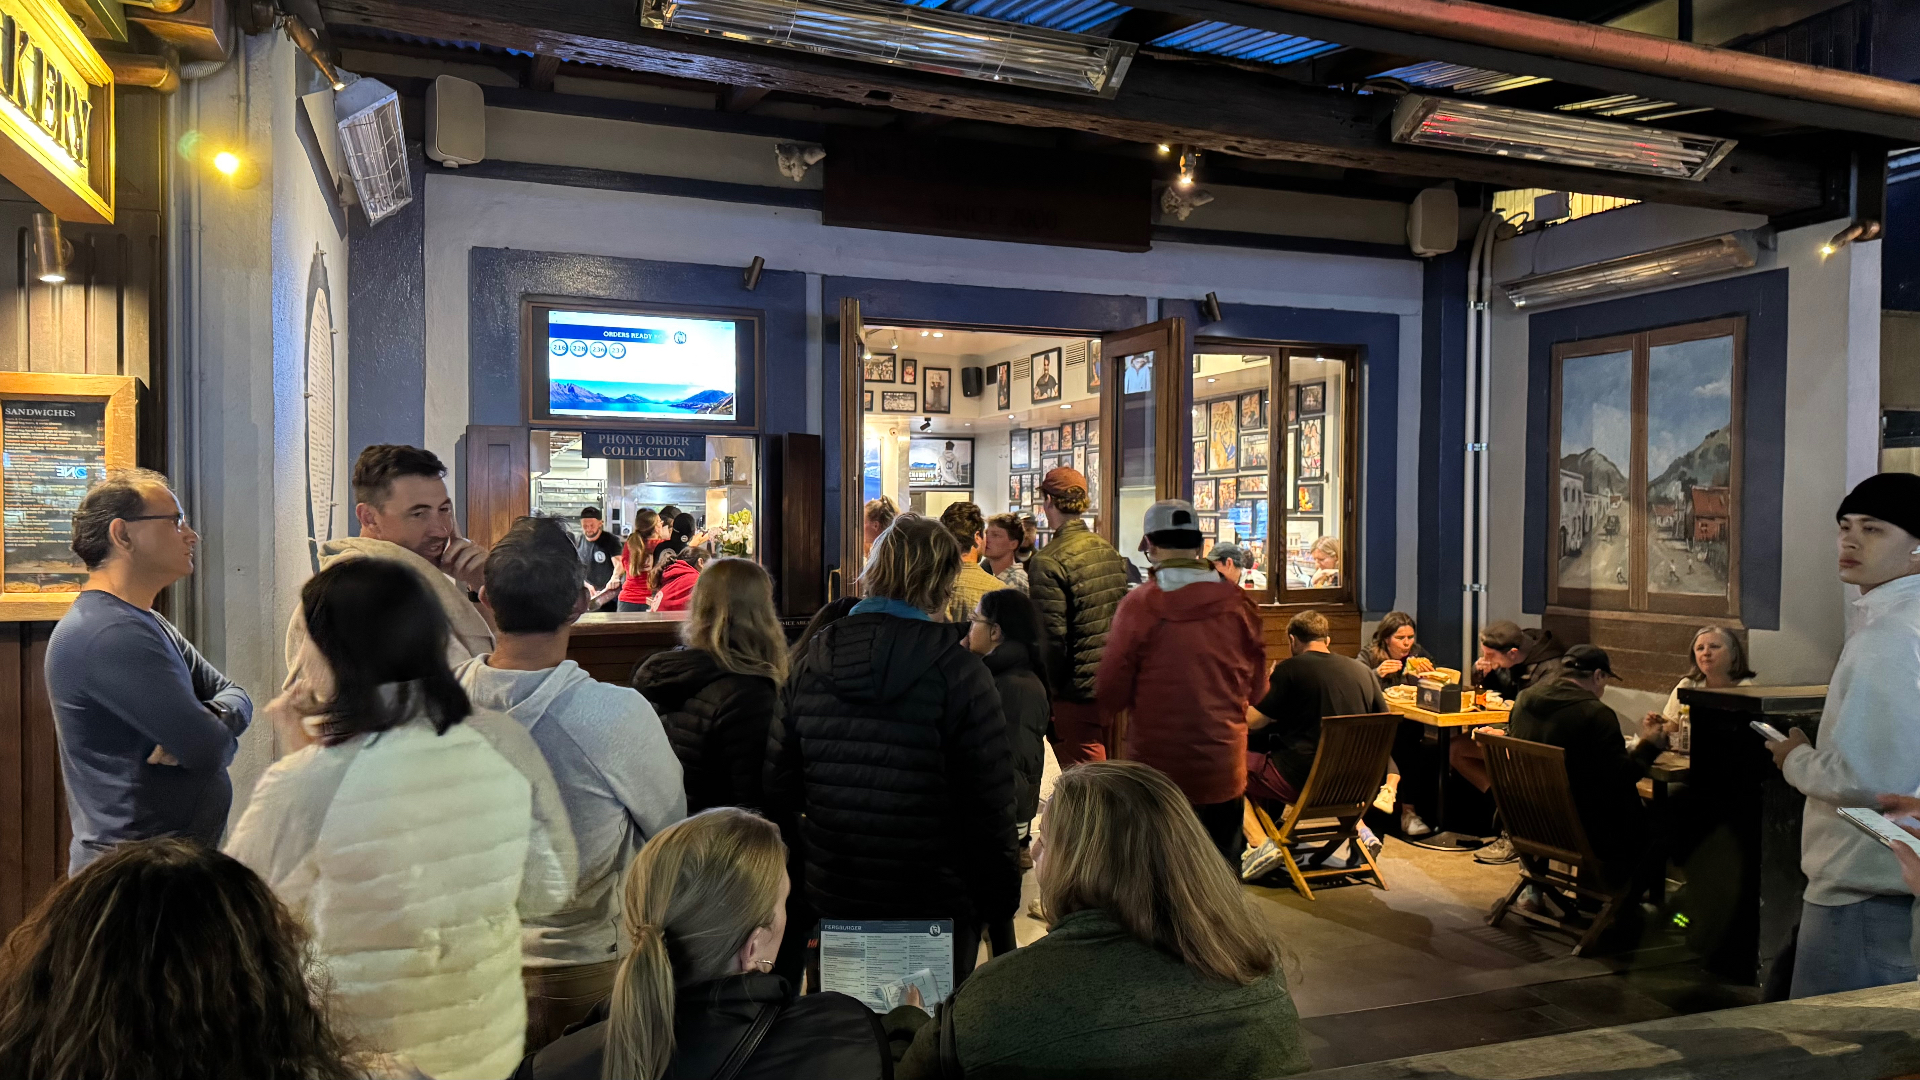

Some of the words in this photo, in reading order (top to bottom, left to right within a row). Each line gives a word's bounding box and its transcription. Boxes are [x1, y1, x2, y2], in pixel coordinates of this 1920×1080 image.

[0, 13, 92, 167] KERY
[603, 330, 630, 338] ORDERS
[4, 408, 76, 417] SANDWICHES
[598, 434, 642, 445] PHONE
[645, 435, 690, 446] ORDER
[602, 446, 686, 457] COLLECTION
